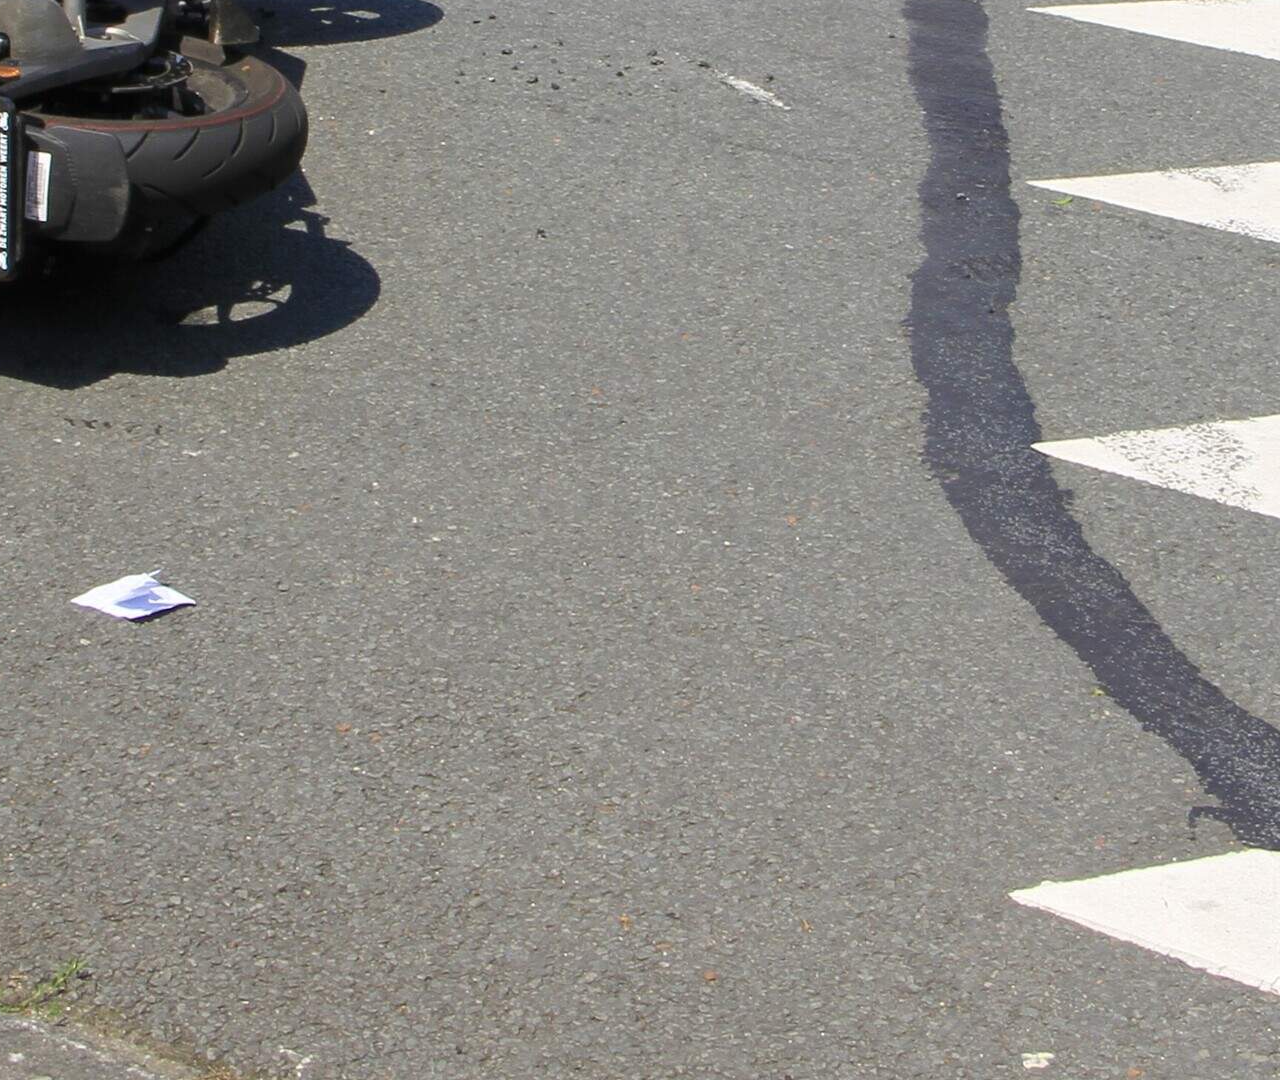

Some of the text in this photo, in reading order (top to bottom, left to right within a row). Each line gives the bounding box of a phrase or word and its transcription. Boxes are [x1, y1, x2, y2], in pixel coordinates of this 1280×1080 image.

[0, 133, 9, 249] DE ZWART MOTOREN WEERT
